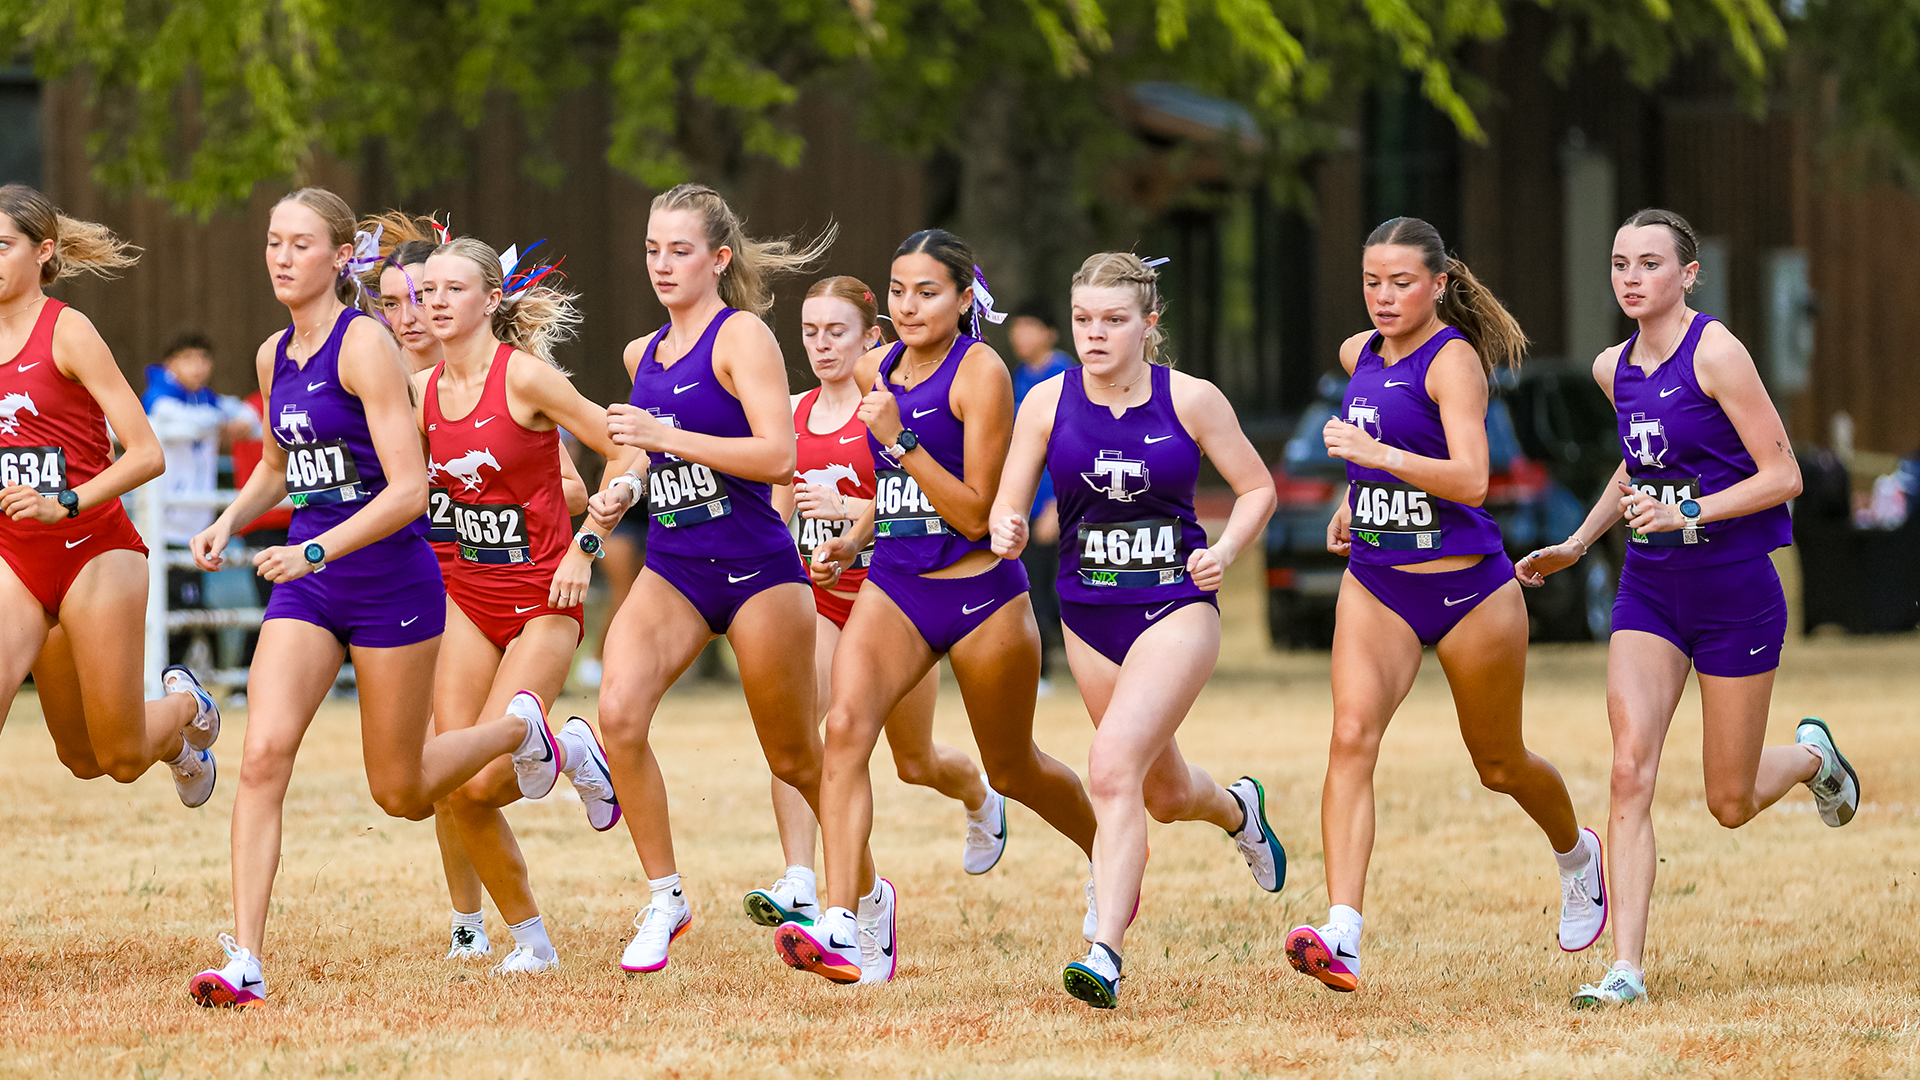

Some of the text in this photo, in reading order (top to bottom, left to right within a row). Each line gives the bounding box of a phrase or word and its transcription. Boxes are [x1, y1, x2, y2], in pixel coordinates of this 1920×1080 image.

[0, 452, 61, 488] 634
[286, 446, 346, 488] 4647
[650, 463, 718, 508] 4649
[1095, 458, 1145, 499] T
[454, 507, 522, 544] 4632
[1355, 487, 1433, 527] 4645
[801, 517, 859, 551] 462
[1084, 525, 1176, 566] 4644
[1092, 571, 1119, 582] NTX
